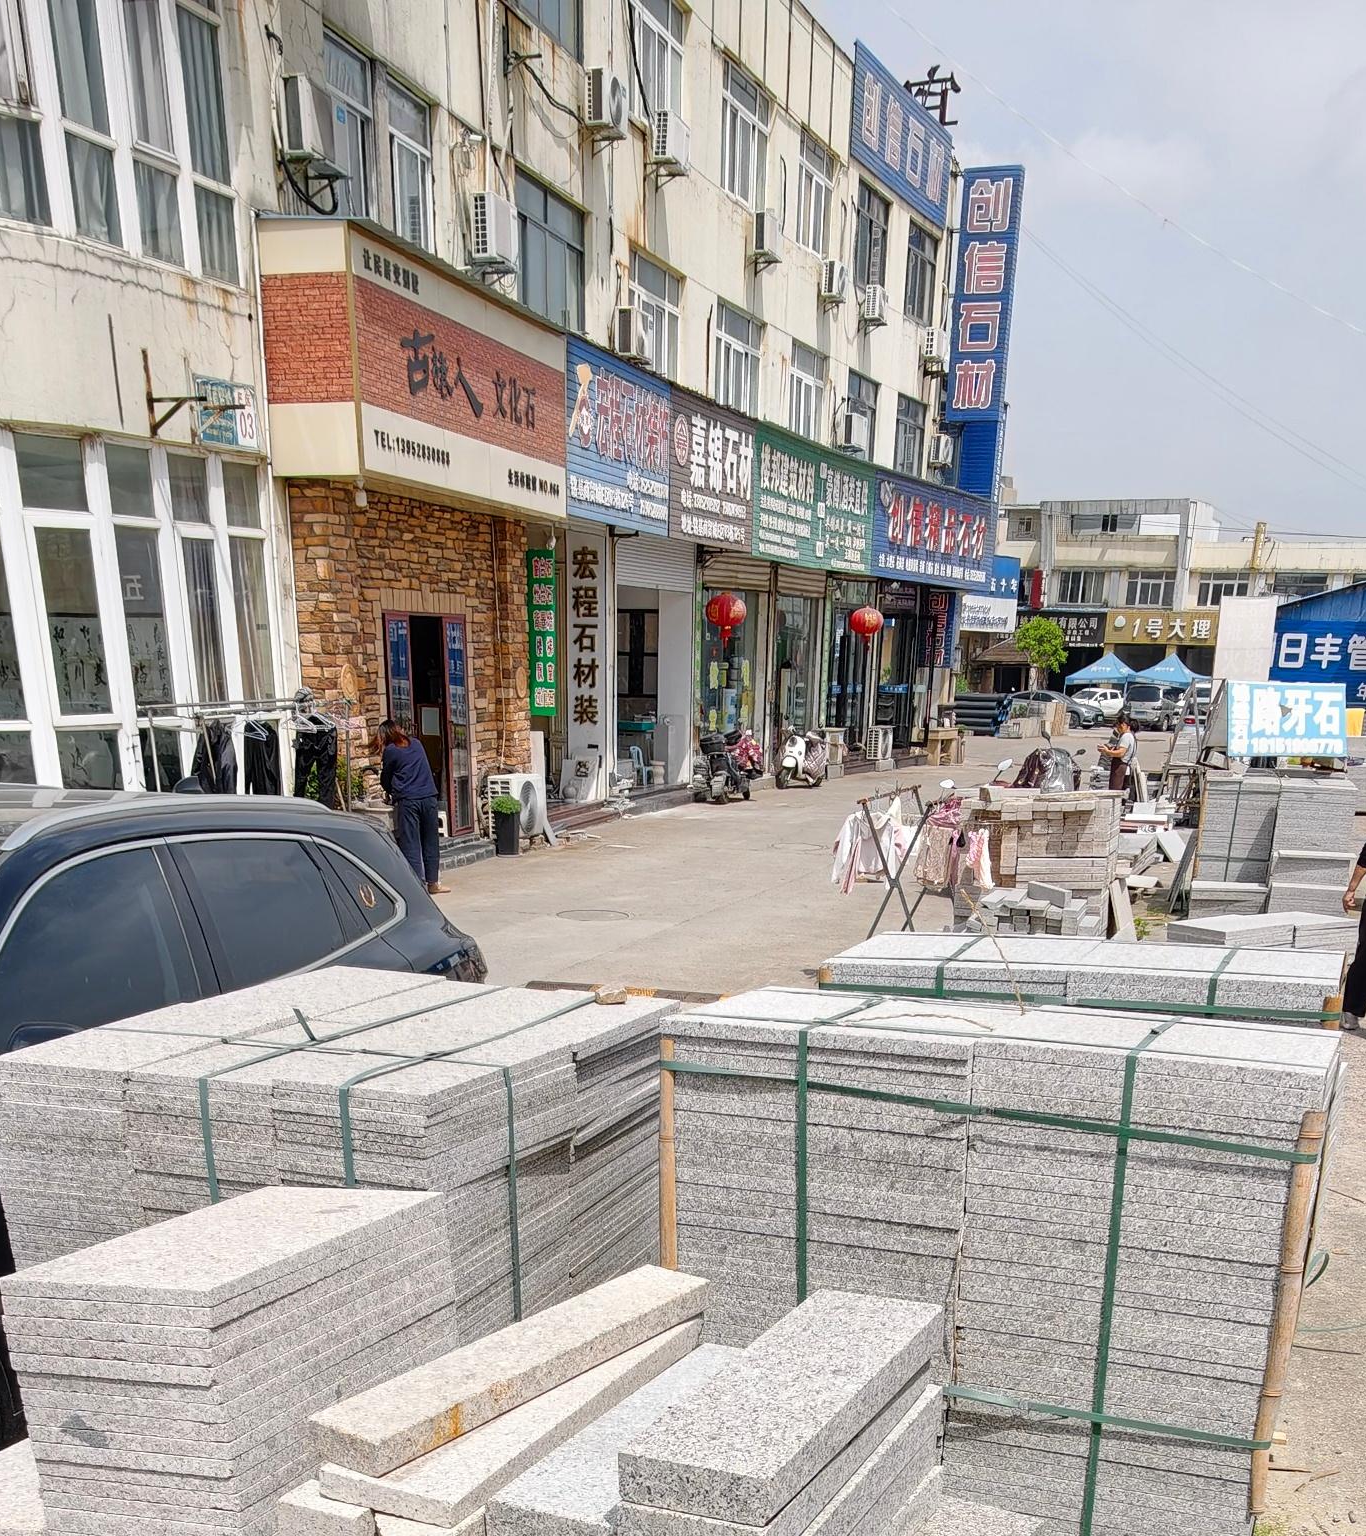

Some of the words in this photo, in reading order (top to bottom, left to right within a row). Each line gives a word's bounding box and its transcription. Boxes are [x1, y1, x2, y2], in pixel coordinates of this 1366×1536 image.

[862, 71, 945, 205] 创信石材
[953, 177, 1013, 410] 创信石材
[239, 411, 254, 439] 03
[689, 413, 754, 500] 嘉锦石材
[887, 493, 988, 561] 创信精品石材
[1132, 617, 1212, 639] 1号大理
[1251, 687, 1343, 736] 路牙石
